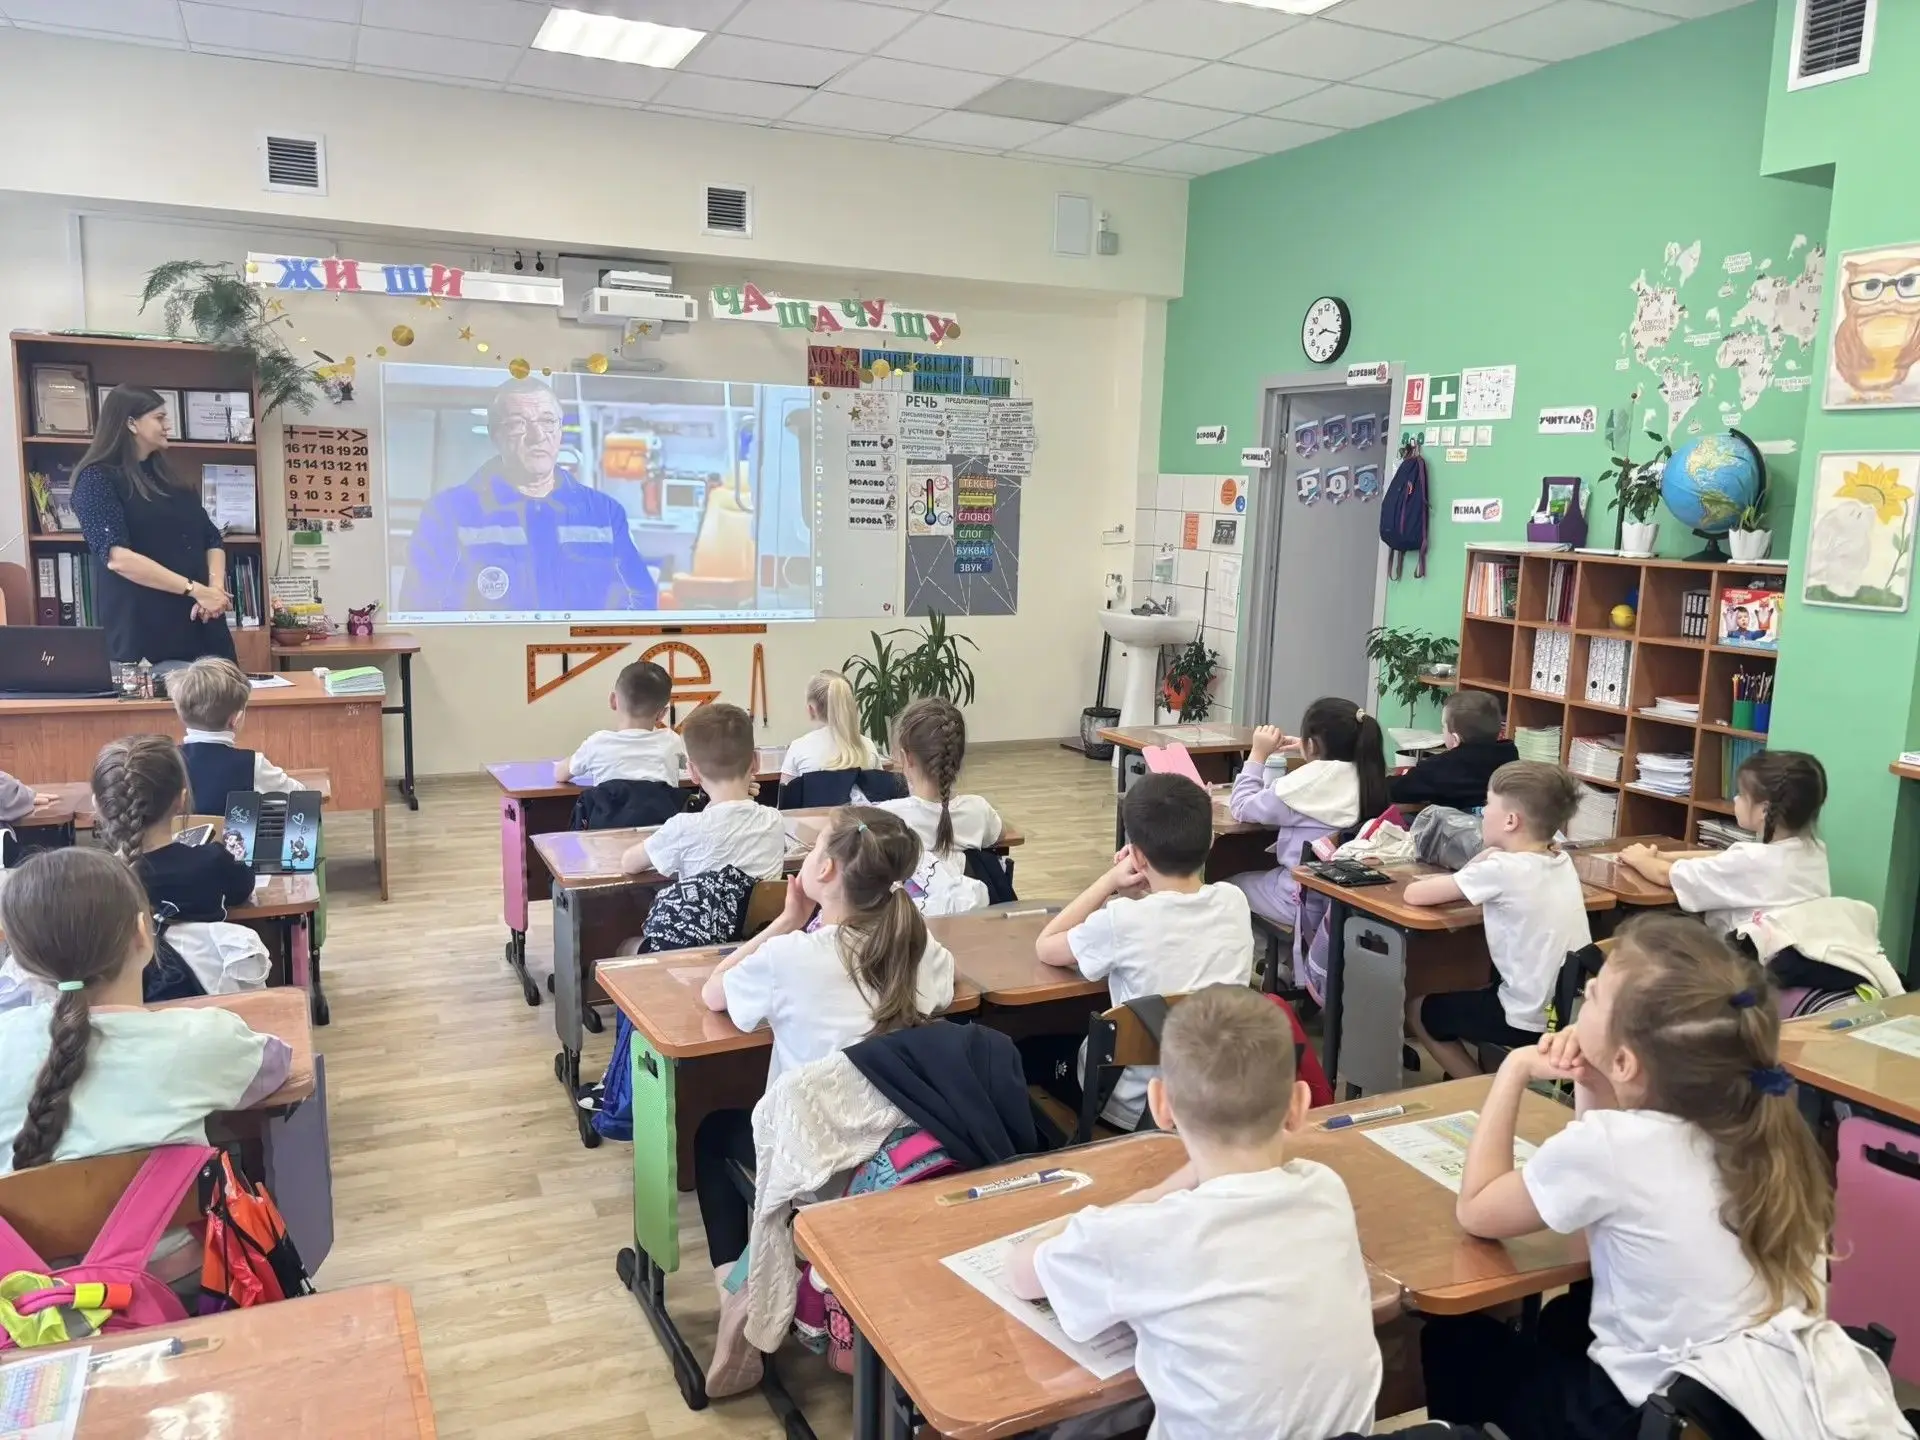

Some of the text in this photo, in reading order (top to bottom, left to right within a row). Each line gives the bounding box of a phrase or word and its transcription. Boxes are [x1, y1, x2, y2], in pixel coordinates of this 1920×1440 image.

[275, 257, 465, 298] ЖИ ШИ
[712, 282, 772, 315] ЧА
[839, 298, 886, 328] ЧУ
[1347, 368, 1377, 378] ДЕРЕВНЯ
[905, 395, 938, 409] РЕЧЬ
[944, 397, 989, 406] ПРЕДЛОЖЕНИЕ
[1538, 415, 1582, 425] УЧИТЕЛЬ
[907, 428, 933, 436] устная
[1196, 432, 1217, 440] ВОРОНА
[285, 443, 368, 456] 16 17 18 19 20
[286, 459, 367, 471] 15 14 13 12 11
[855, 459, 876, 467] ЗАЯЦ
[289, 474, 365, 486] 6 7 5 4 8
[849, 478, 884, 487] МОЛОКО
[963, 480, 990, 489] ТЕКСТ
[289, 490, 364, 502] 9 10 3 2 1
[850, 497, 885, 506] ВОРОБЕЙ
[1453, 505, 1481, 515] ПЕНАЛ
[849, 516, 882, 525] КОРОВА
[958, 512, 991, 522] СЛОВО
[959, 529, 983, 539] СЛОГ
[956, 546, 986, 556] БУКВА
[959, 563, 983, 573] ЗВУК
